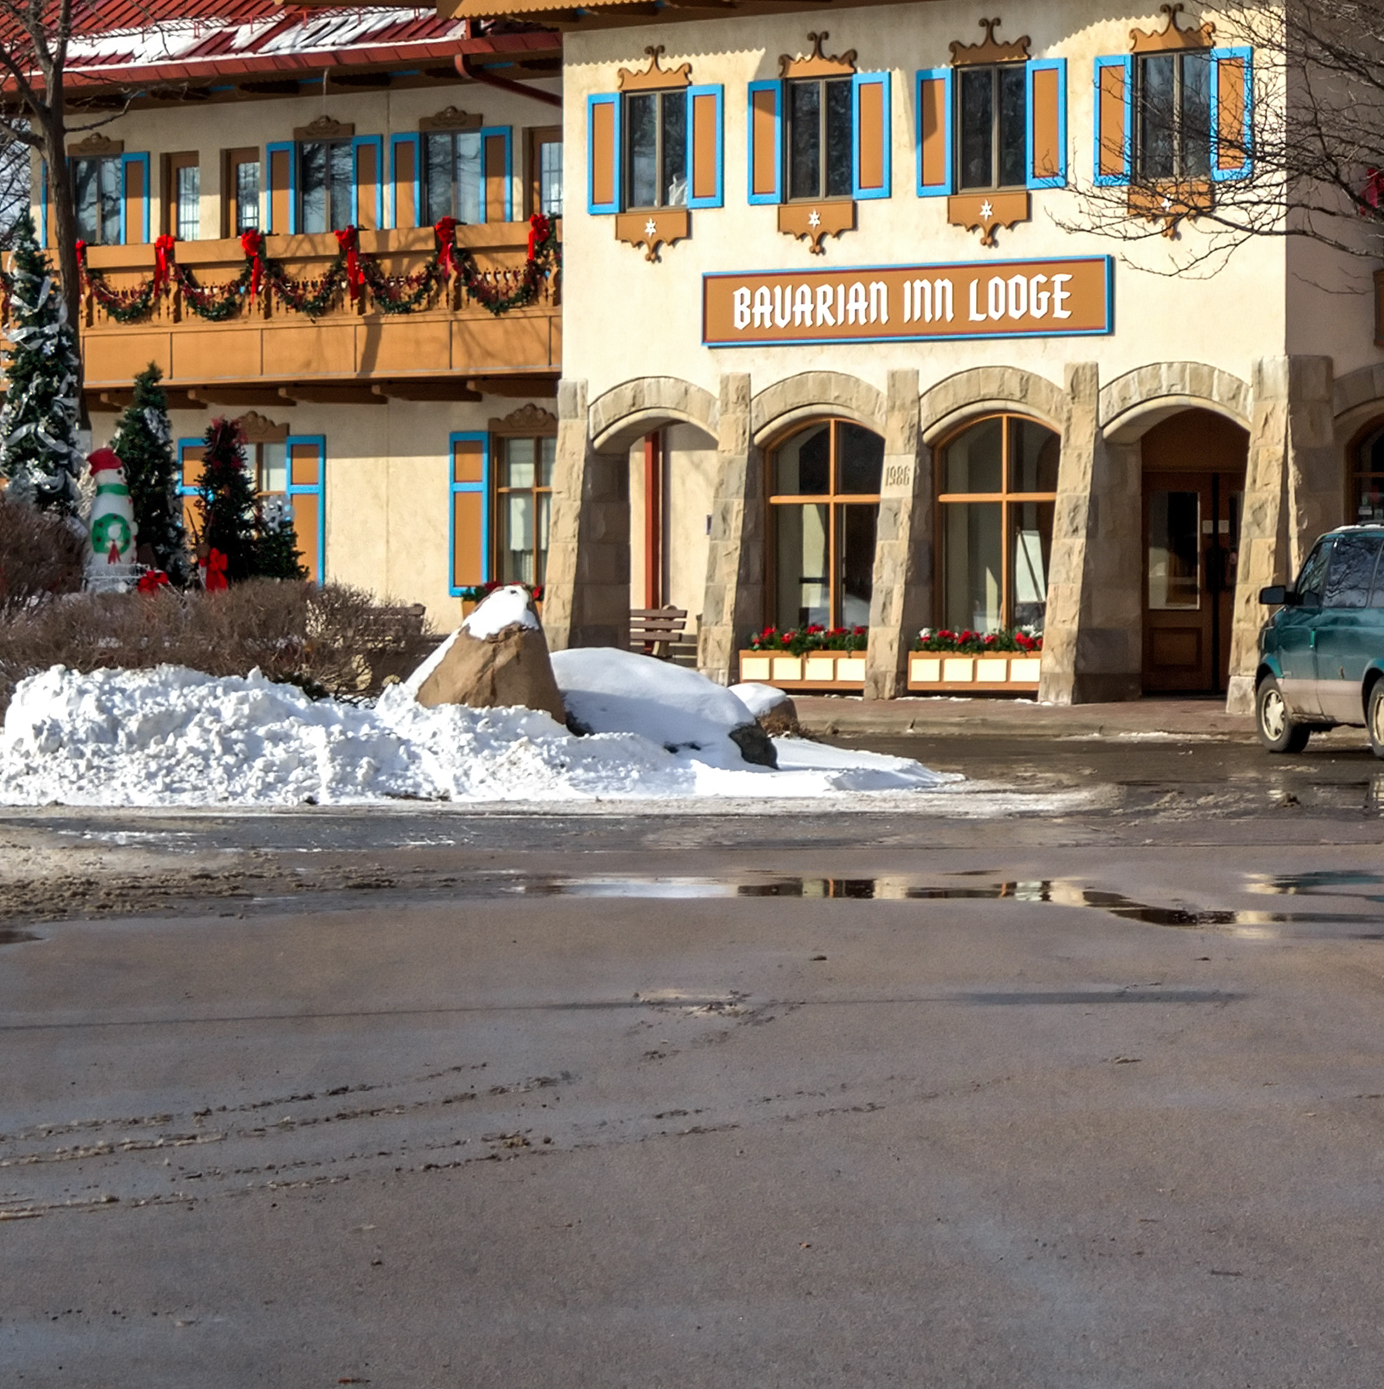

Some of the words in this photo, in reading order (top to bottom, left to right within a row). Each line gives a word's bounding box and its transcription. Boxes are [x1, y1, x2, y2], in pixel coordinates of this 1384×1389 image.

[732, 280, 890, 330] BAVARIAN
[903, 277, 956, 323] INN
[968, 273, 1073, 322] LODGE
[885, 465, 911, 487] 1986
